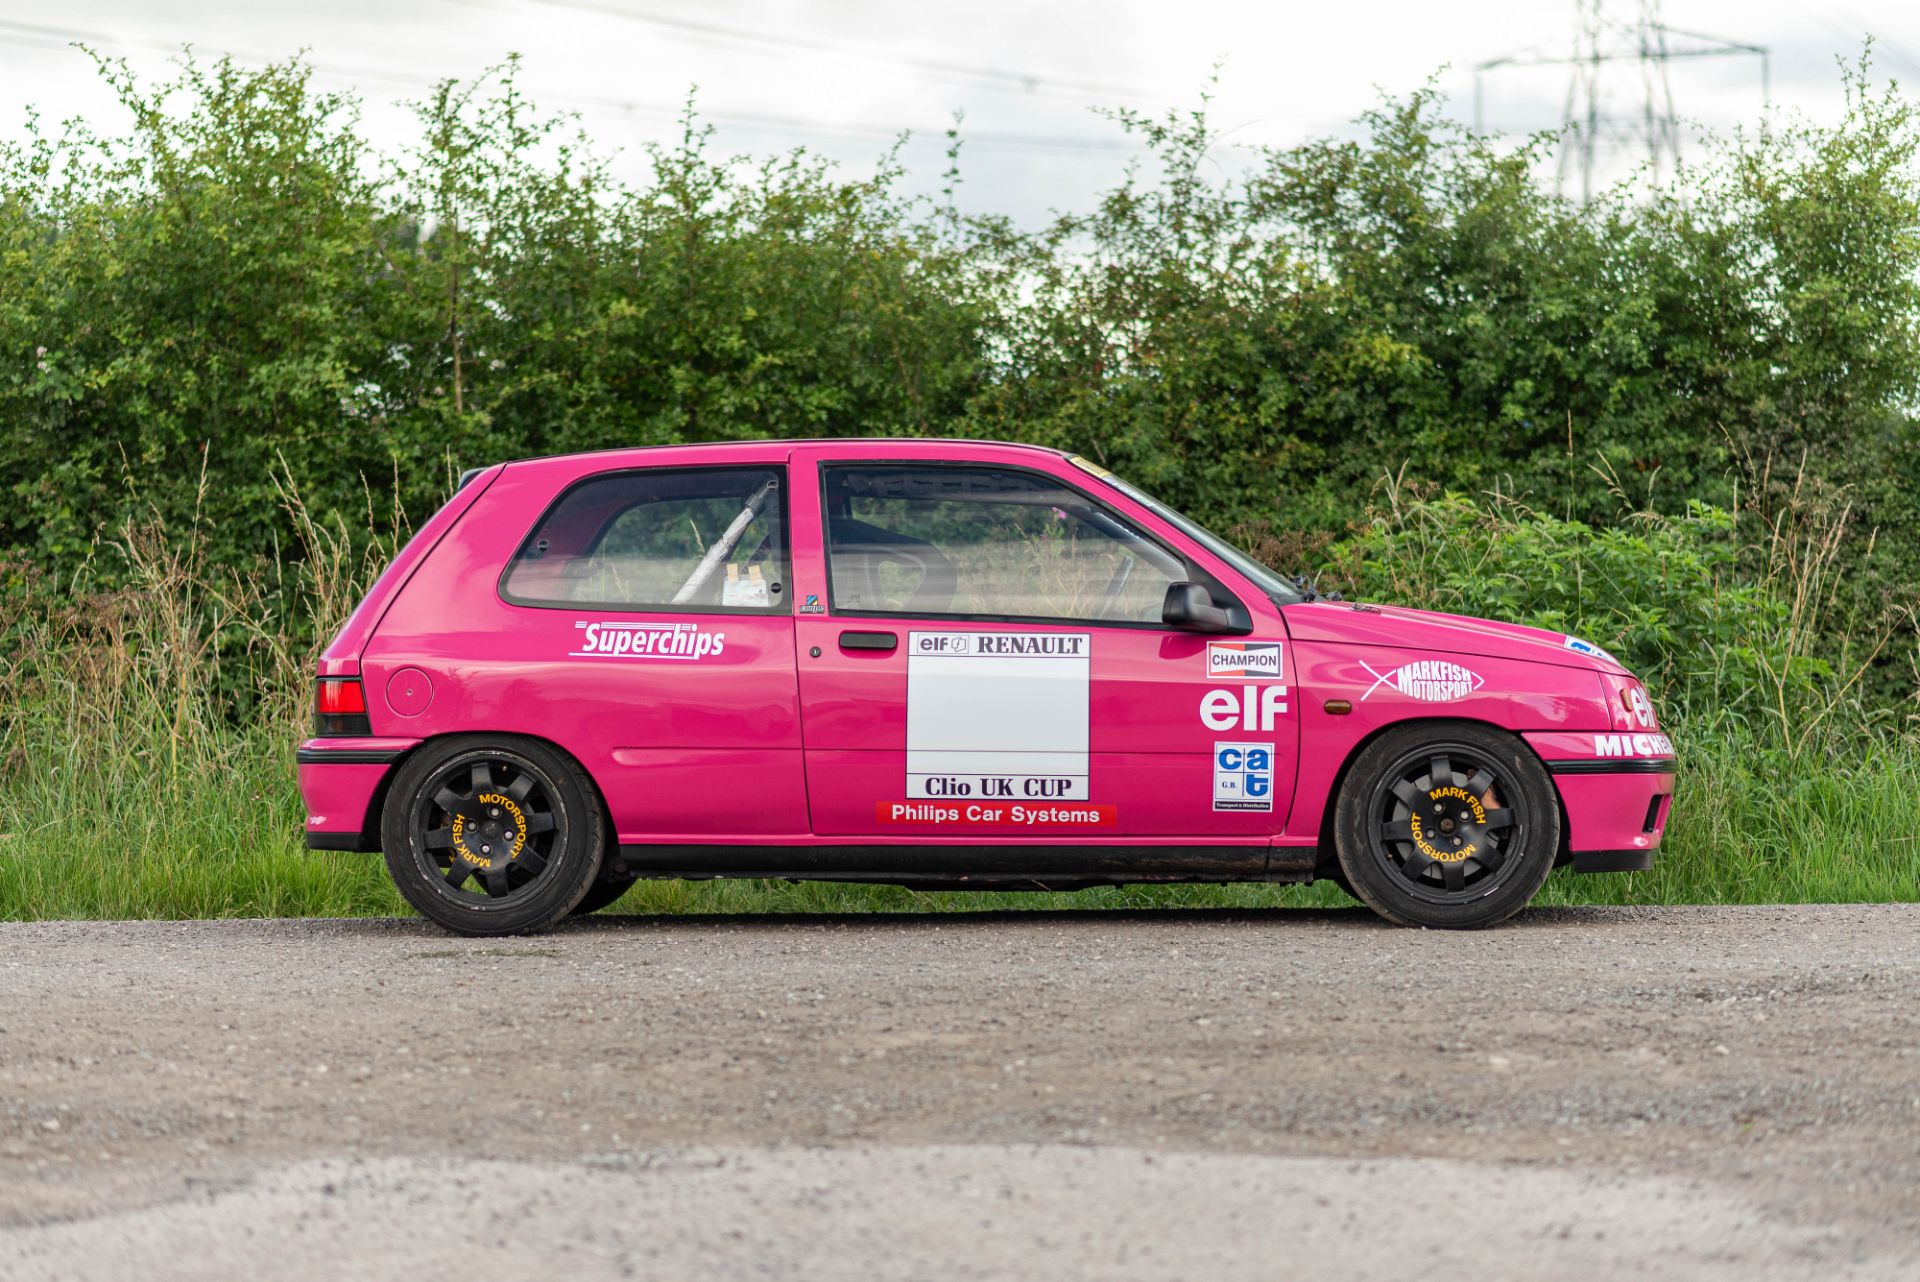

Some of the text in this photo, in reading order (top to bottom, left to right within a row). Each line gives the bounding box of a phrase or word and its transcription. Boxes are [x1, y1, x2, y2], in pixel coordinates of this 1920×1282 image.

[582, 623, 725, 660] Superchips
[920, 636, 1083, 654] elf RENAULT
[1212, 654, 1277, 666] CHAMPION
[1200, 686, 1288, 731] elf
[925, 777, 1072, 797] Clio UK CUP
[1429, 787, 1486, 824] MARK FISH
[479, 794, 527, 859] MOTORSPORT
[892, 804, 1100, 824] Philips Car Systems
[452, 813, 491, 868] MARK FISH
[1411, 812, 1476, 861] MOTORSPORT
